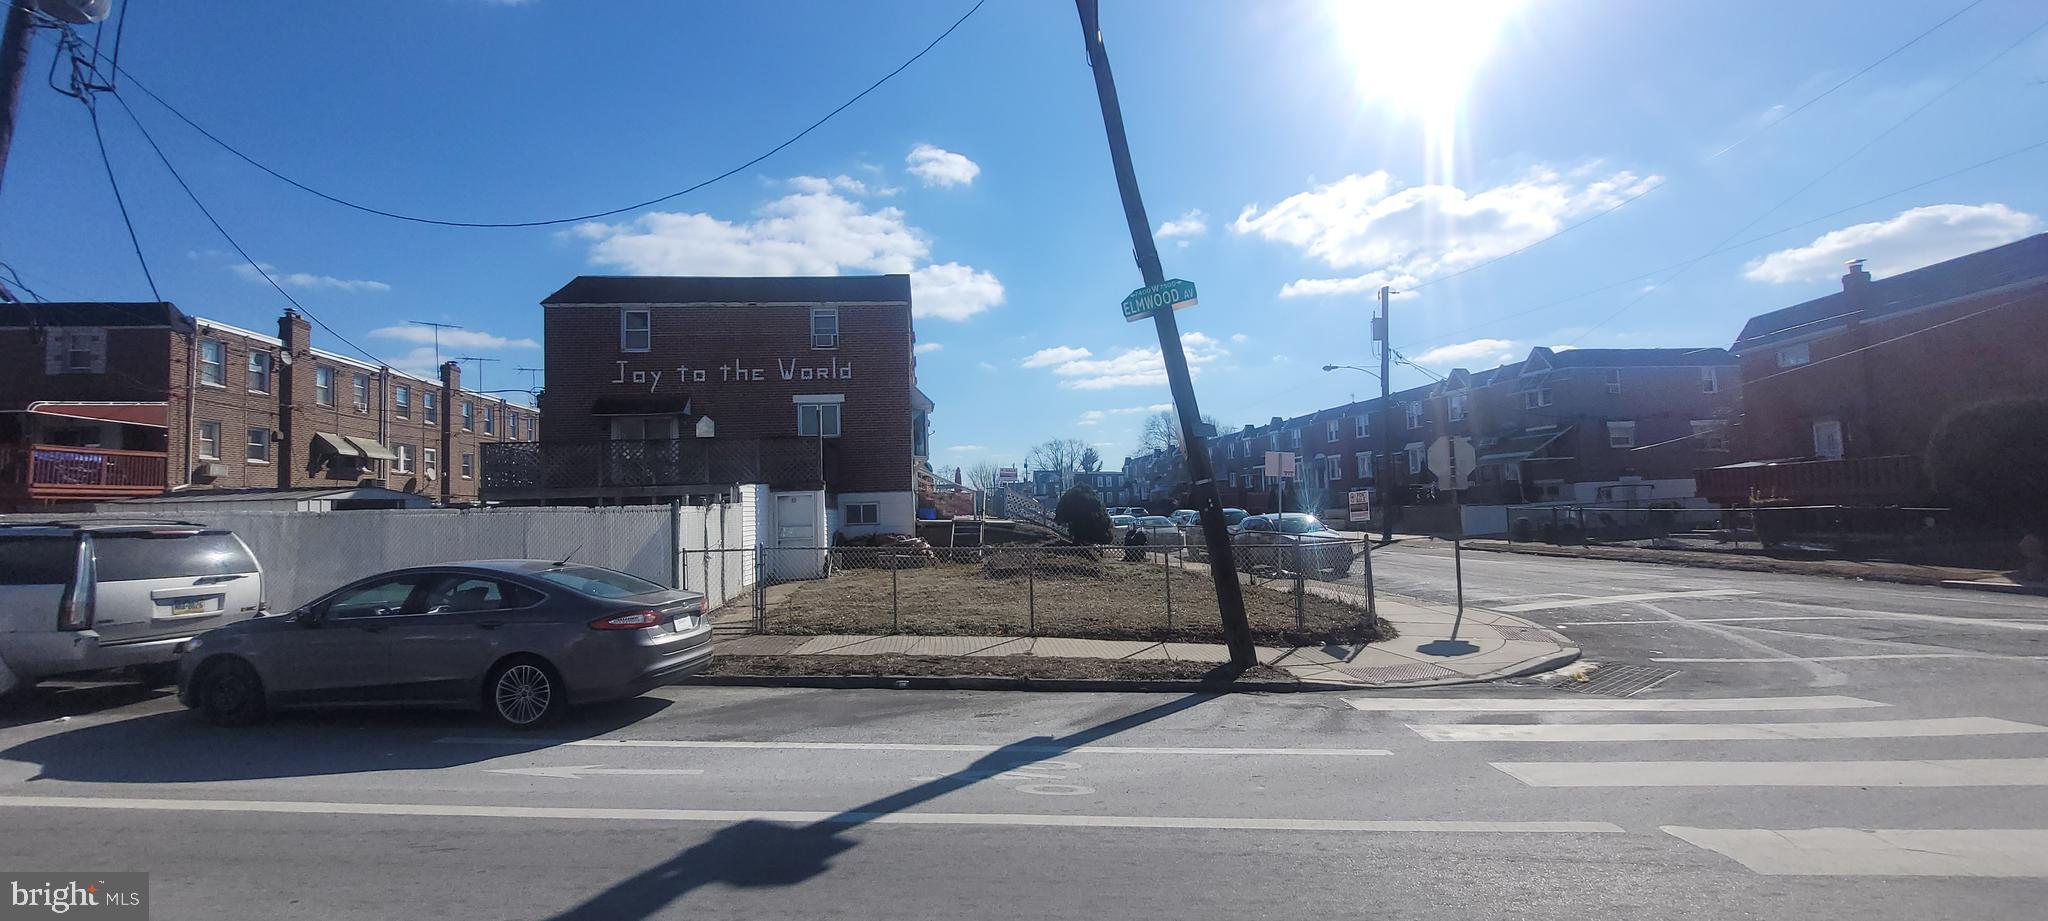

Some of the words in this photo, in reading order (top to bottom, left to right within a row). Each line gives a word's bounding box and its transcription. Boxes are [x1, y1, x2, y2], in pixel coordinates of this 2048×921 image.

[1123, 289, 1179, 316] ELMWOOD
[1184, 288, 1194, 299] AV
[1151, 284, 1159, 292] W
[612, 360, 662, 394] Joy
[677, 365, 706, 382] to
